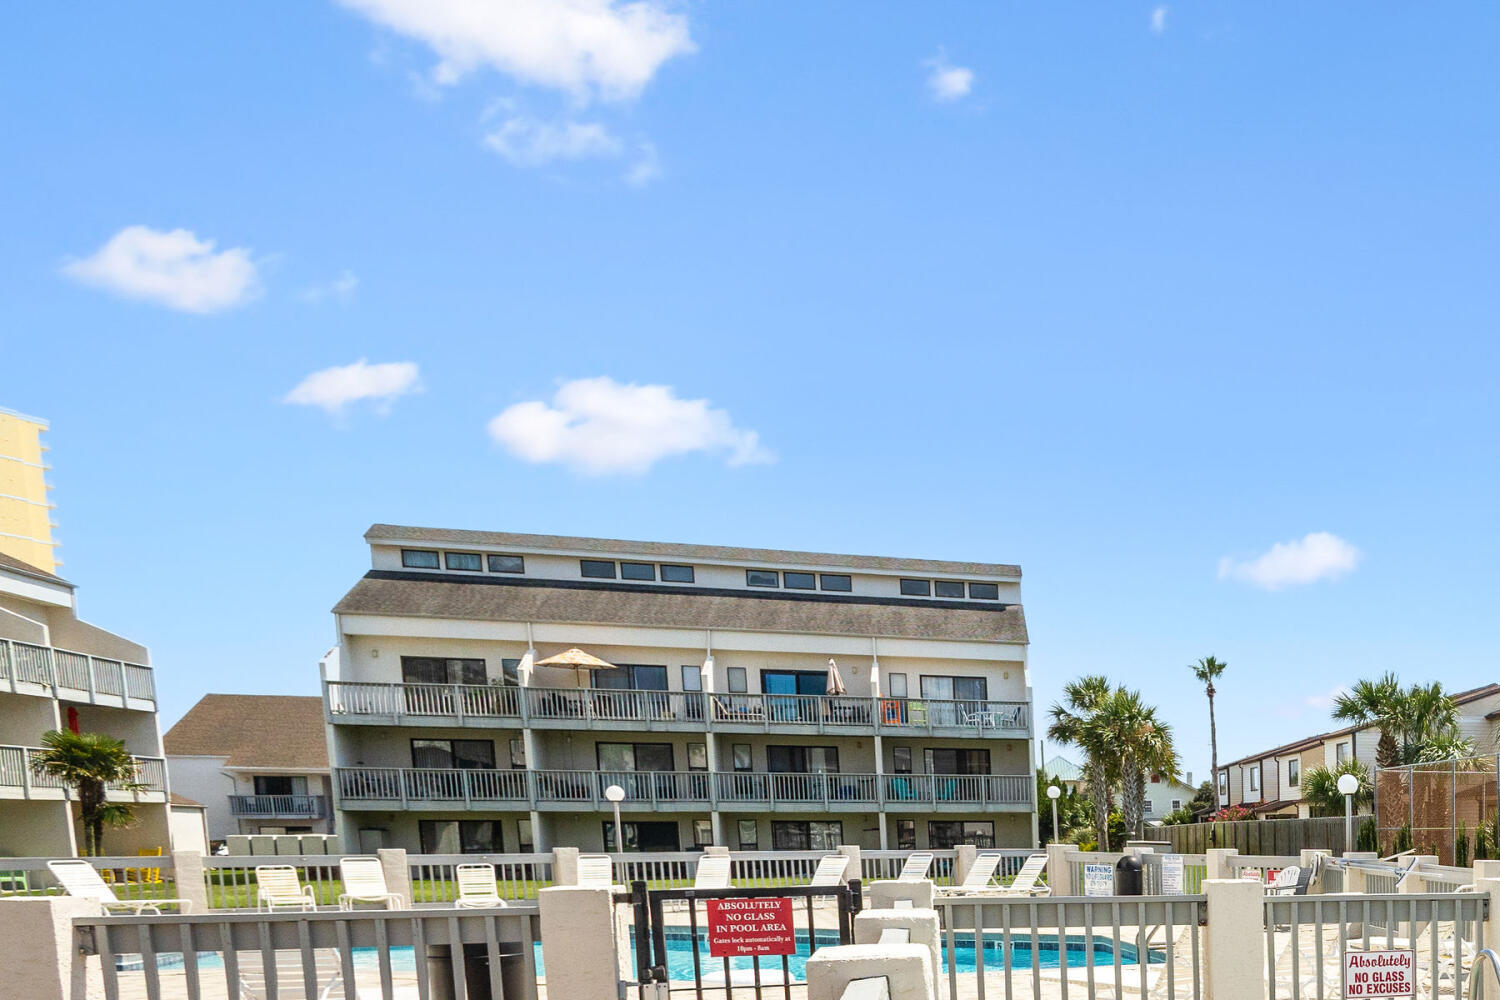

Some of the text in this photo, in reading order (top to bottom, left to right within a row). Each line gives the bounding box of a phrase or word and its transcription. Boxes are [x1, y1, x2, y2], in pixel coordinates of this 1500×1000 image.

[718, 901, 782, 910] ABSOLUTELY
[726, 912, 775, 921] NO GLASS
[716, 923, 787, 933] IN POOL AREA
[745, 936, 784, 944] automatically
[1349, 954, 1411, 969] Absolutely
[1354, 971, 1405, 983] NO GLASS
[1349, 982, 1411, 995] NO EXCUSES
